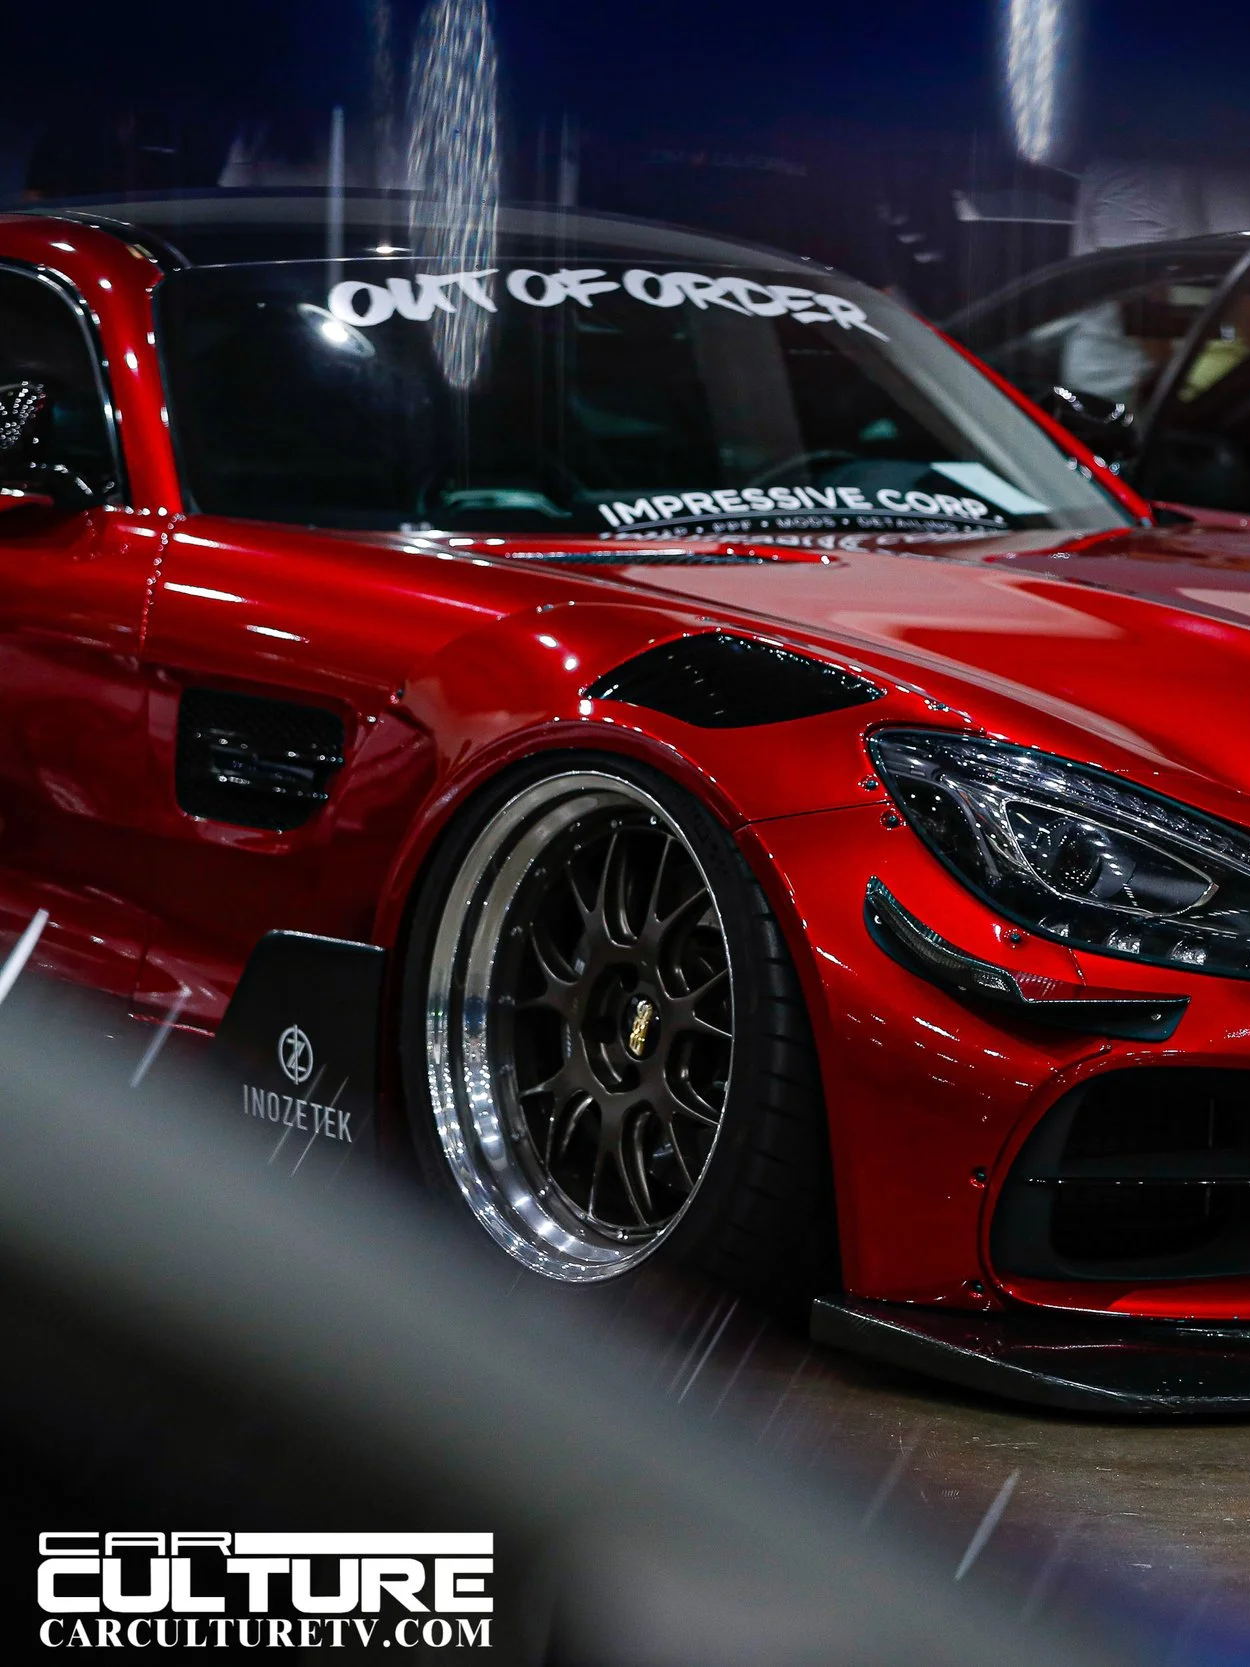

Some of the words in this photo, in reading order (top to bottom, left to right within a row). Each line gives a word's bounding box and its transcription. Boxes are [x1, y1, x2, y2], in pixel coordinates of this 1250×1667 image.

[329, 268, 499, 327] OUT
[506, 268, 620, 308] OF
[622, 268, 890, 342] ORDER
[598, 486, 874, 528] IMPRESSIVE
[876, 488, 1004, 525] CORP.
[243, 1083, 354, 1143] INOZETEK
